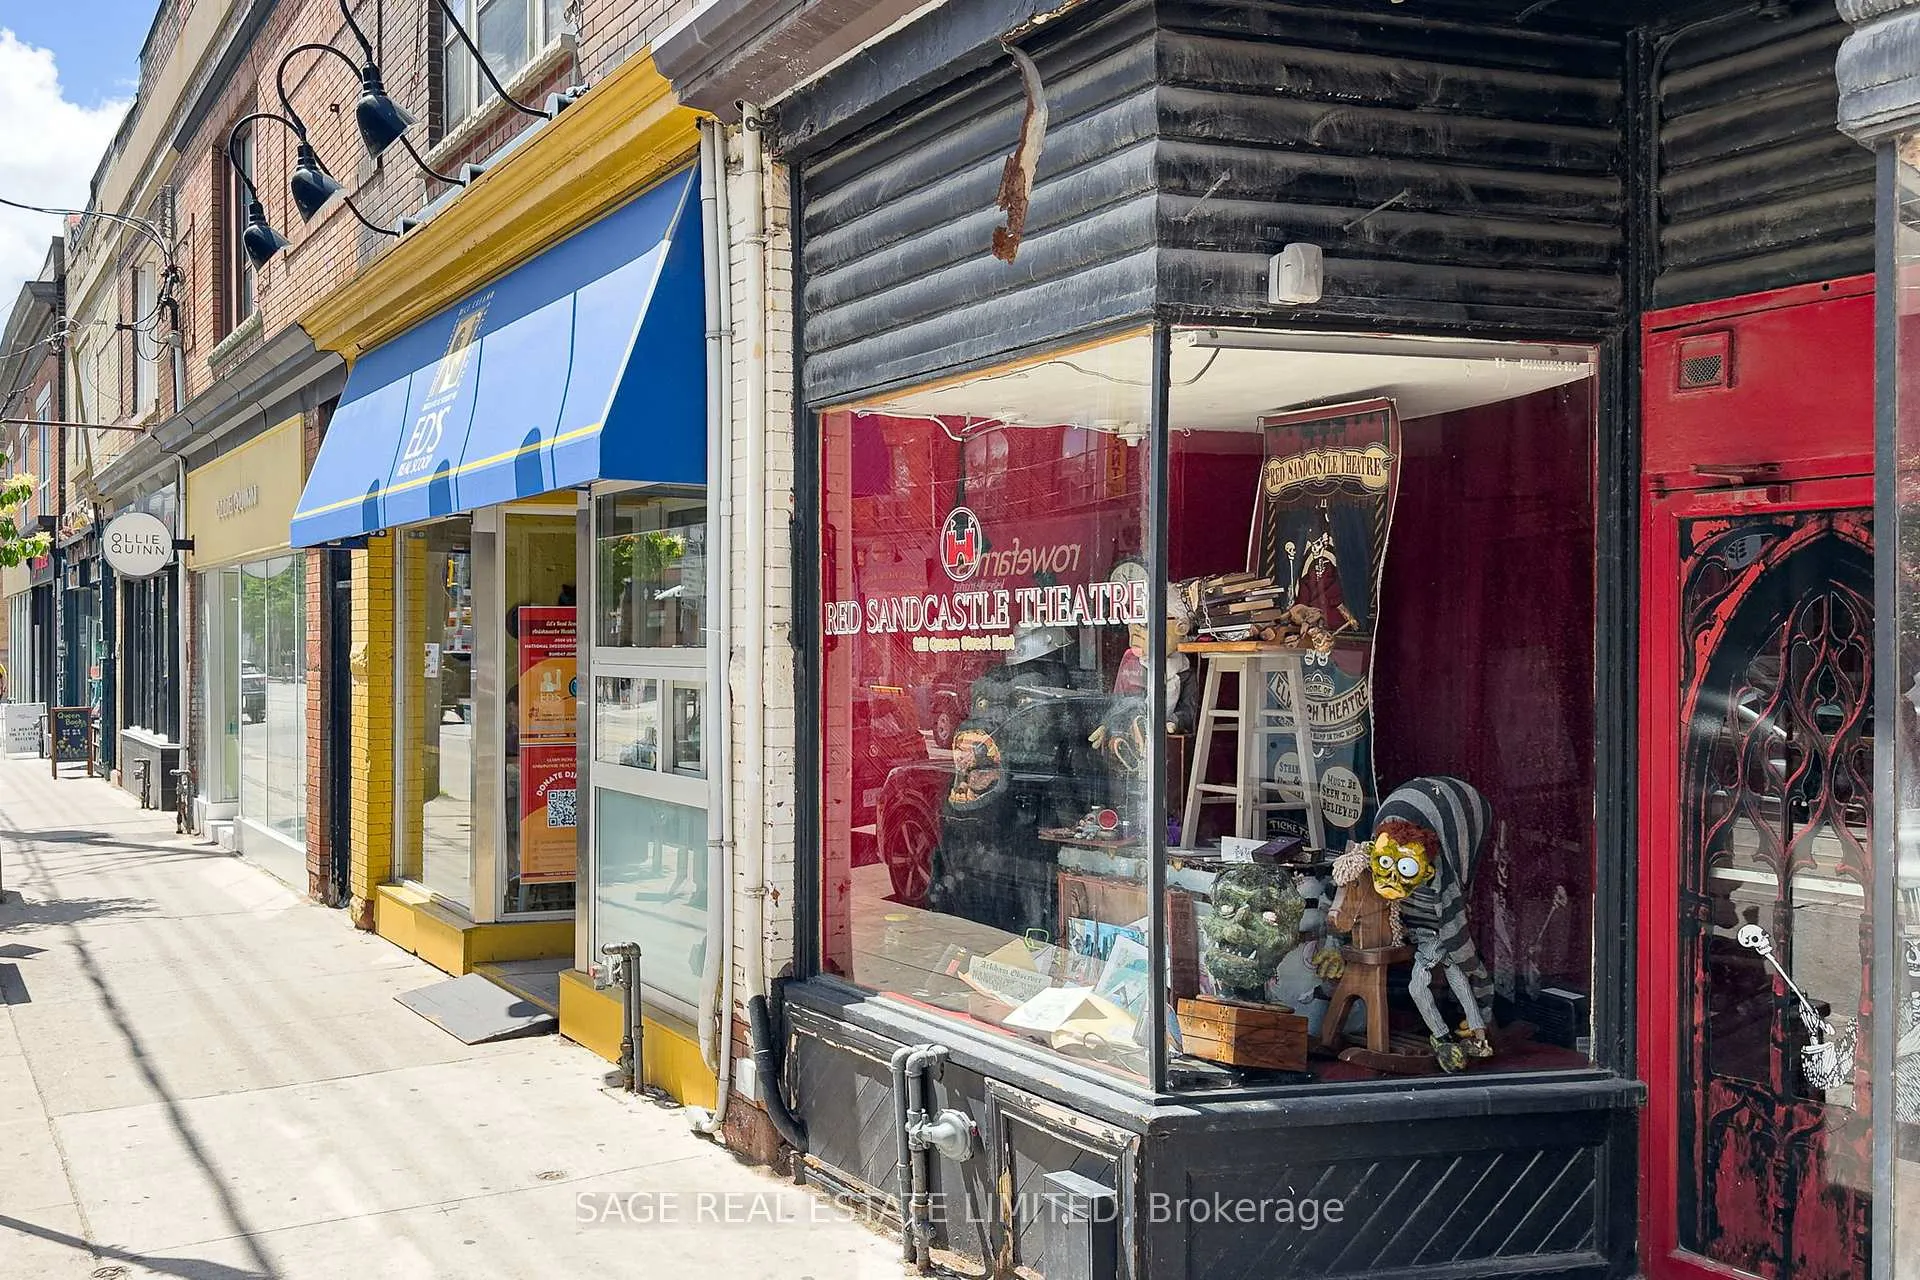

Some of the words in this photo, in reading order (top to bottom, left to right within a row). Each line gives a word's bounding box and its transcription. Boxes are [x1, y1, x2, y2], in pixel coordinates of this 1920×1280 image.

[1270, 468, 1286, 487] RED
[1288, 456, 1338, 480] SANDCASTLE
[1340, 452, 1381, 476] THEATRE
[111, 532, 160, 545] OLLIE
[111, 543, 165, 555] QUINN
[824, 600, 862, 635] RED
[866, 590, 1010, 634] SANDCASTLE
[1015, 580, 1149, 627] THEATRE
[1320, 684, 1369, 723] THEATRE
[536, 770, 563, 797] DONATE
[1326, 774, 1346, 788] MUST
[1347, 778, 1357, 790] BE
[1322, 786, 1340, 800] SEEN
[1341, 792, 1351, 802] TO
[1322, 799, 1359, 820] BELIEVED
[1269, 820, 1311, 839] TICKETS
